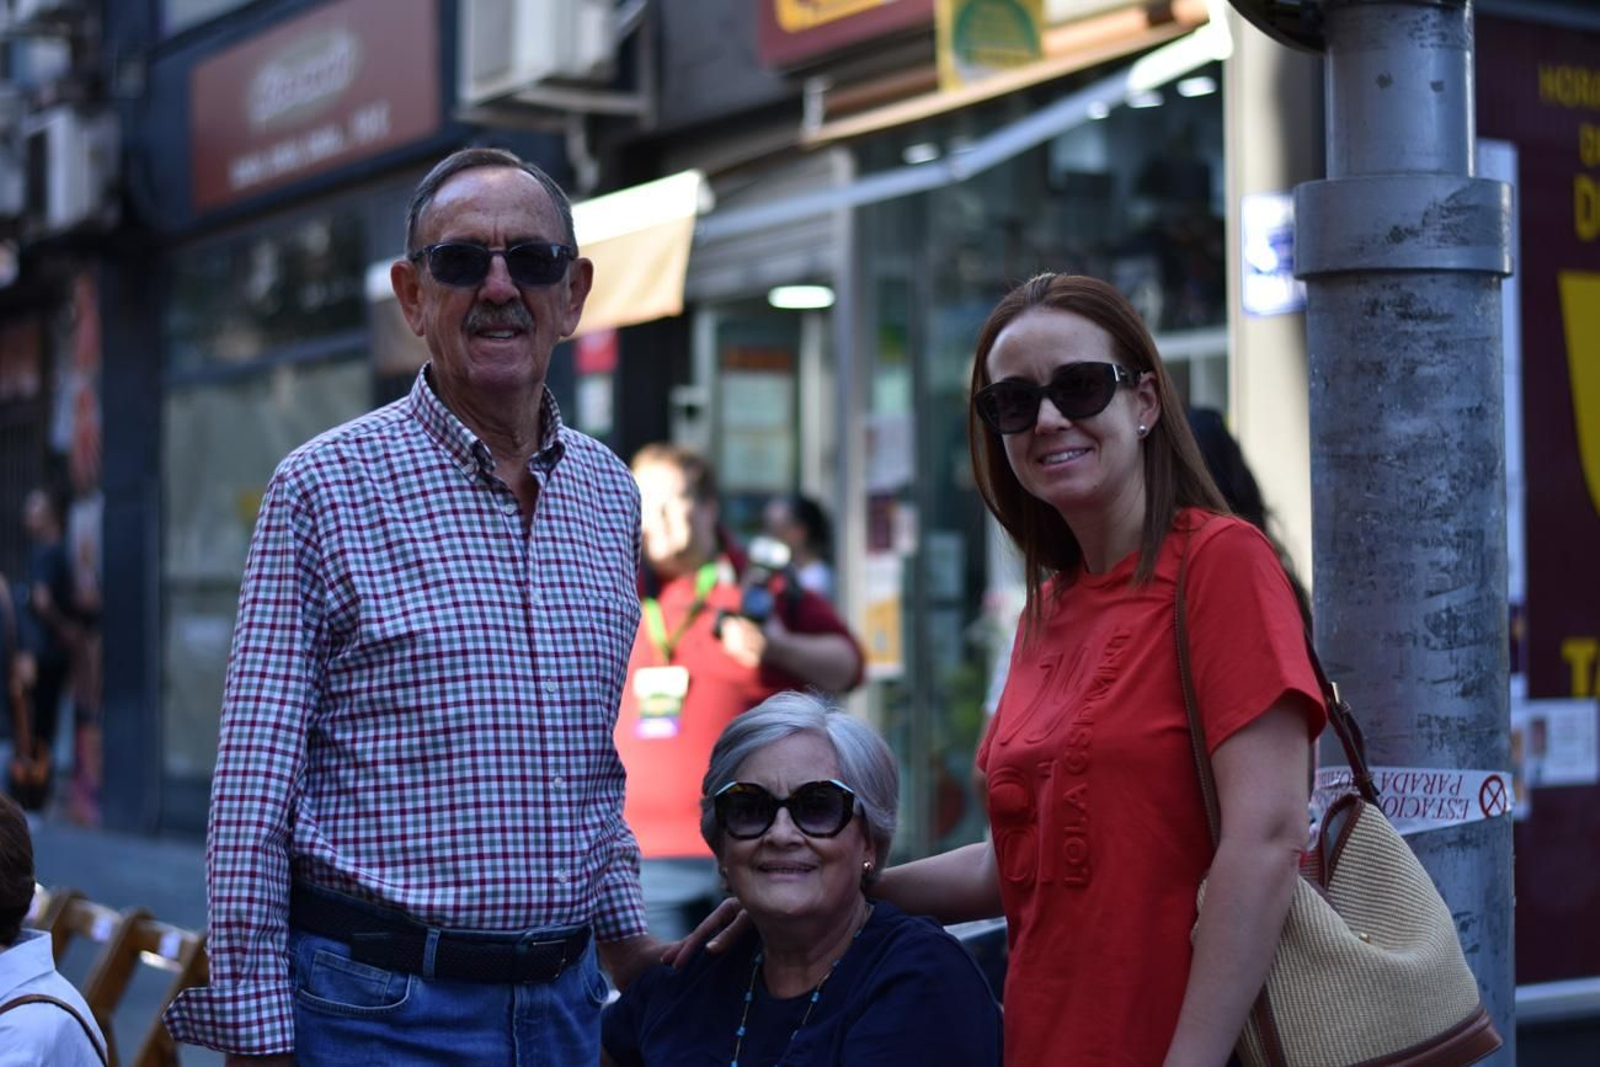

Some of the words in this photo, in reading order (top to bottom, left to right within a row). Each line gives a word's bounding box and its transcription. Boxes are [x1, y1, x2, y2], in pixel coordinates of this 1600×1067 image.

[1575, 176, 1600, 241] D
[1562, 639, 1600, 697] T
[1381, 773, 1463, 795] PARADA
[1381, 796, 1470, 820] ESTACIO
[1063, 783, 1089, 887] LOLA
